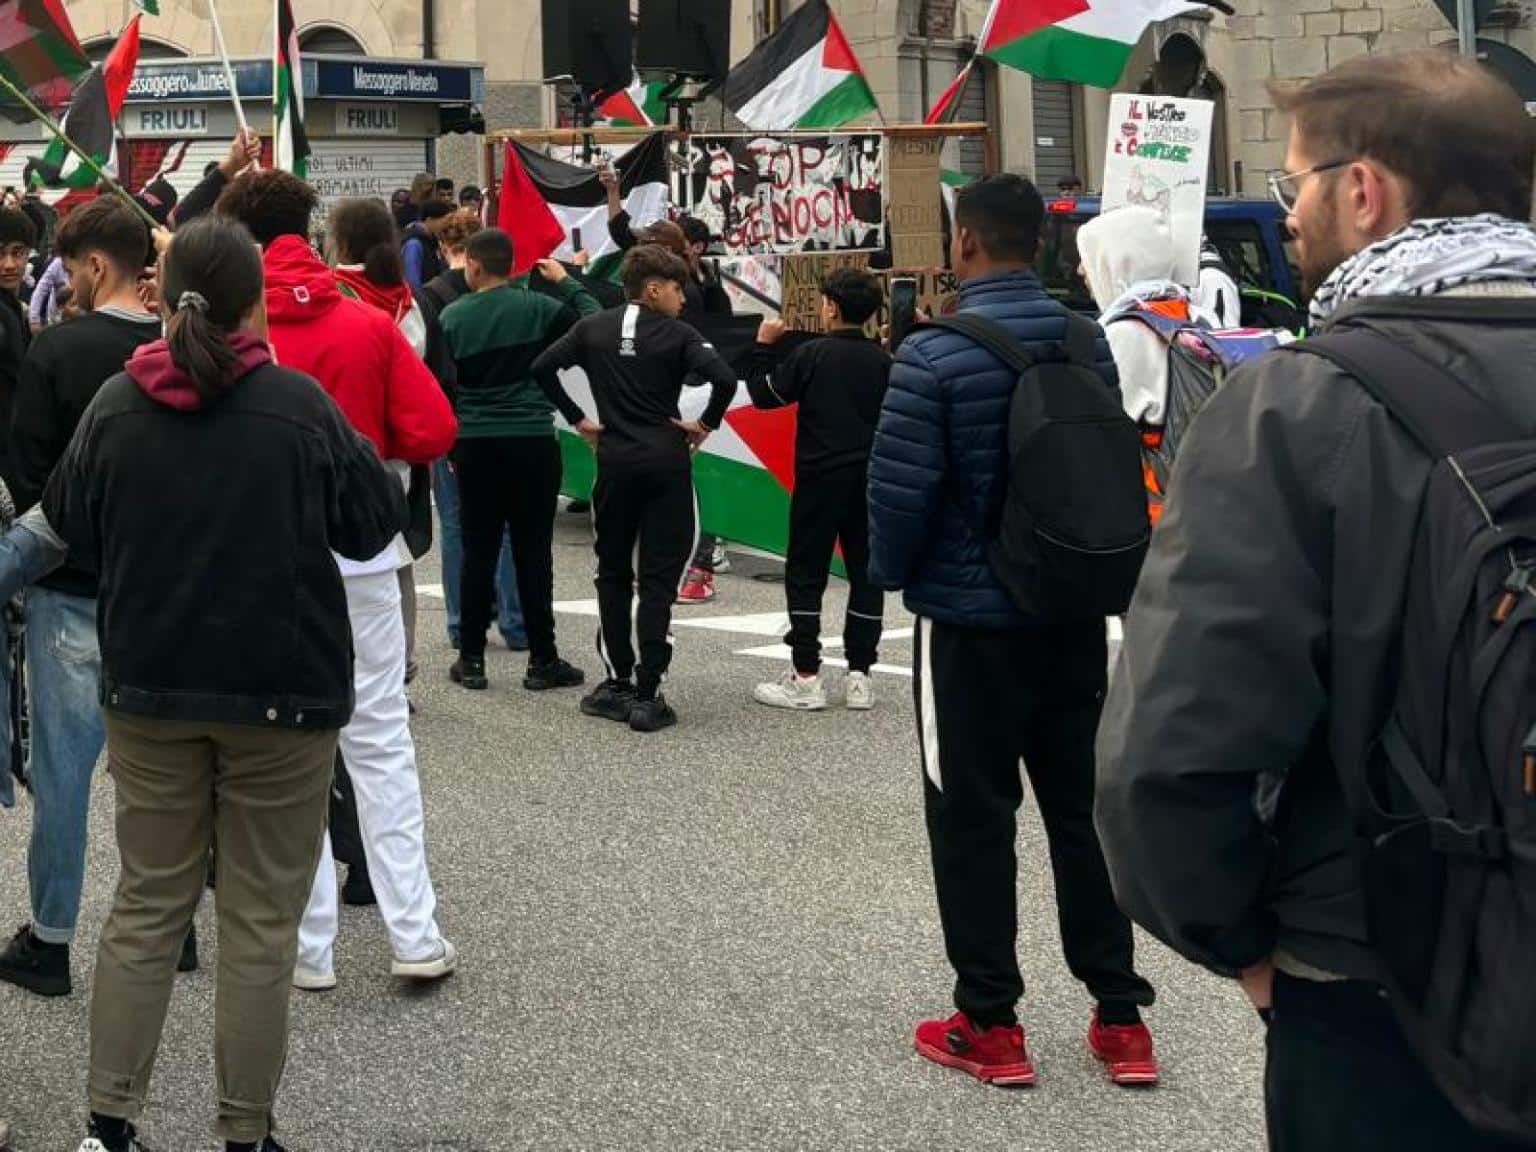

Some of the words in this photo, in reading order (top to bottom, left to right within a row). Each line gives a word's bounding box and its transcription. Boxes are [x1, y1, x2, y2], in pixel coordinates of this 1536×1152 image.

[127, 72, 189, 96] essaggero
[141, 109, 207, 130] FRIULI
[346, 107, 398, 129] FRIULI
